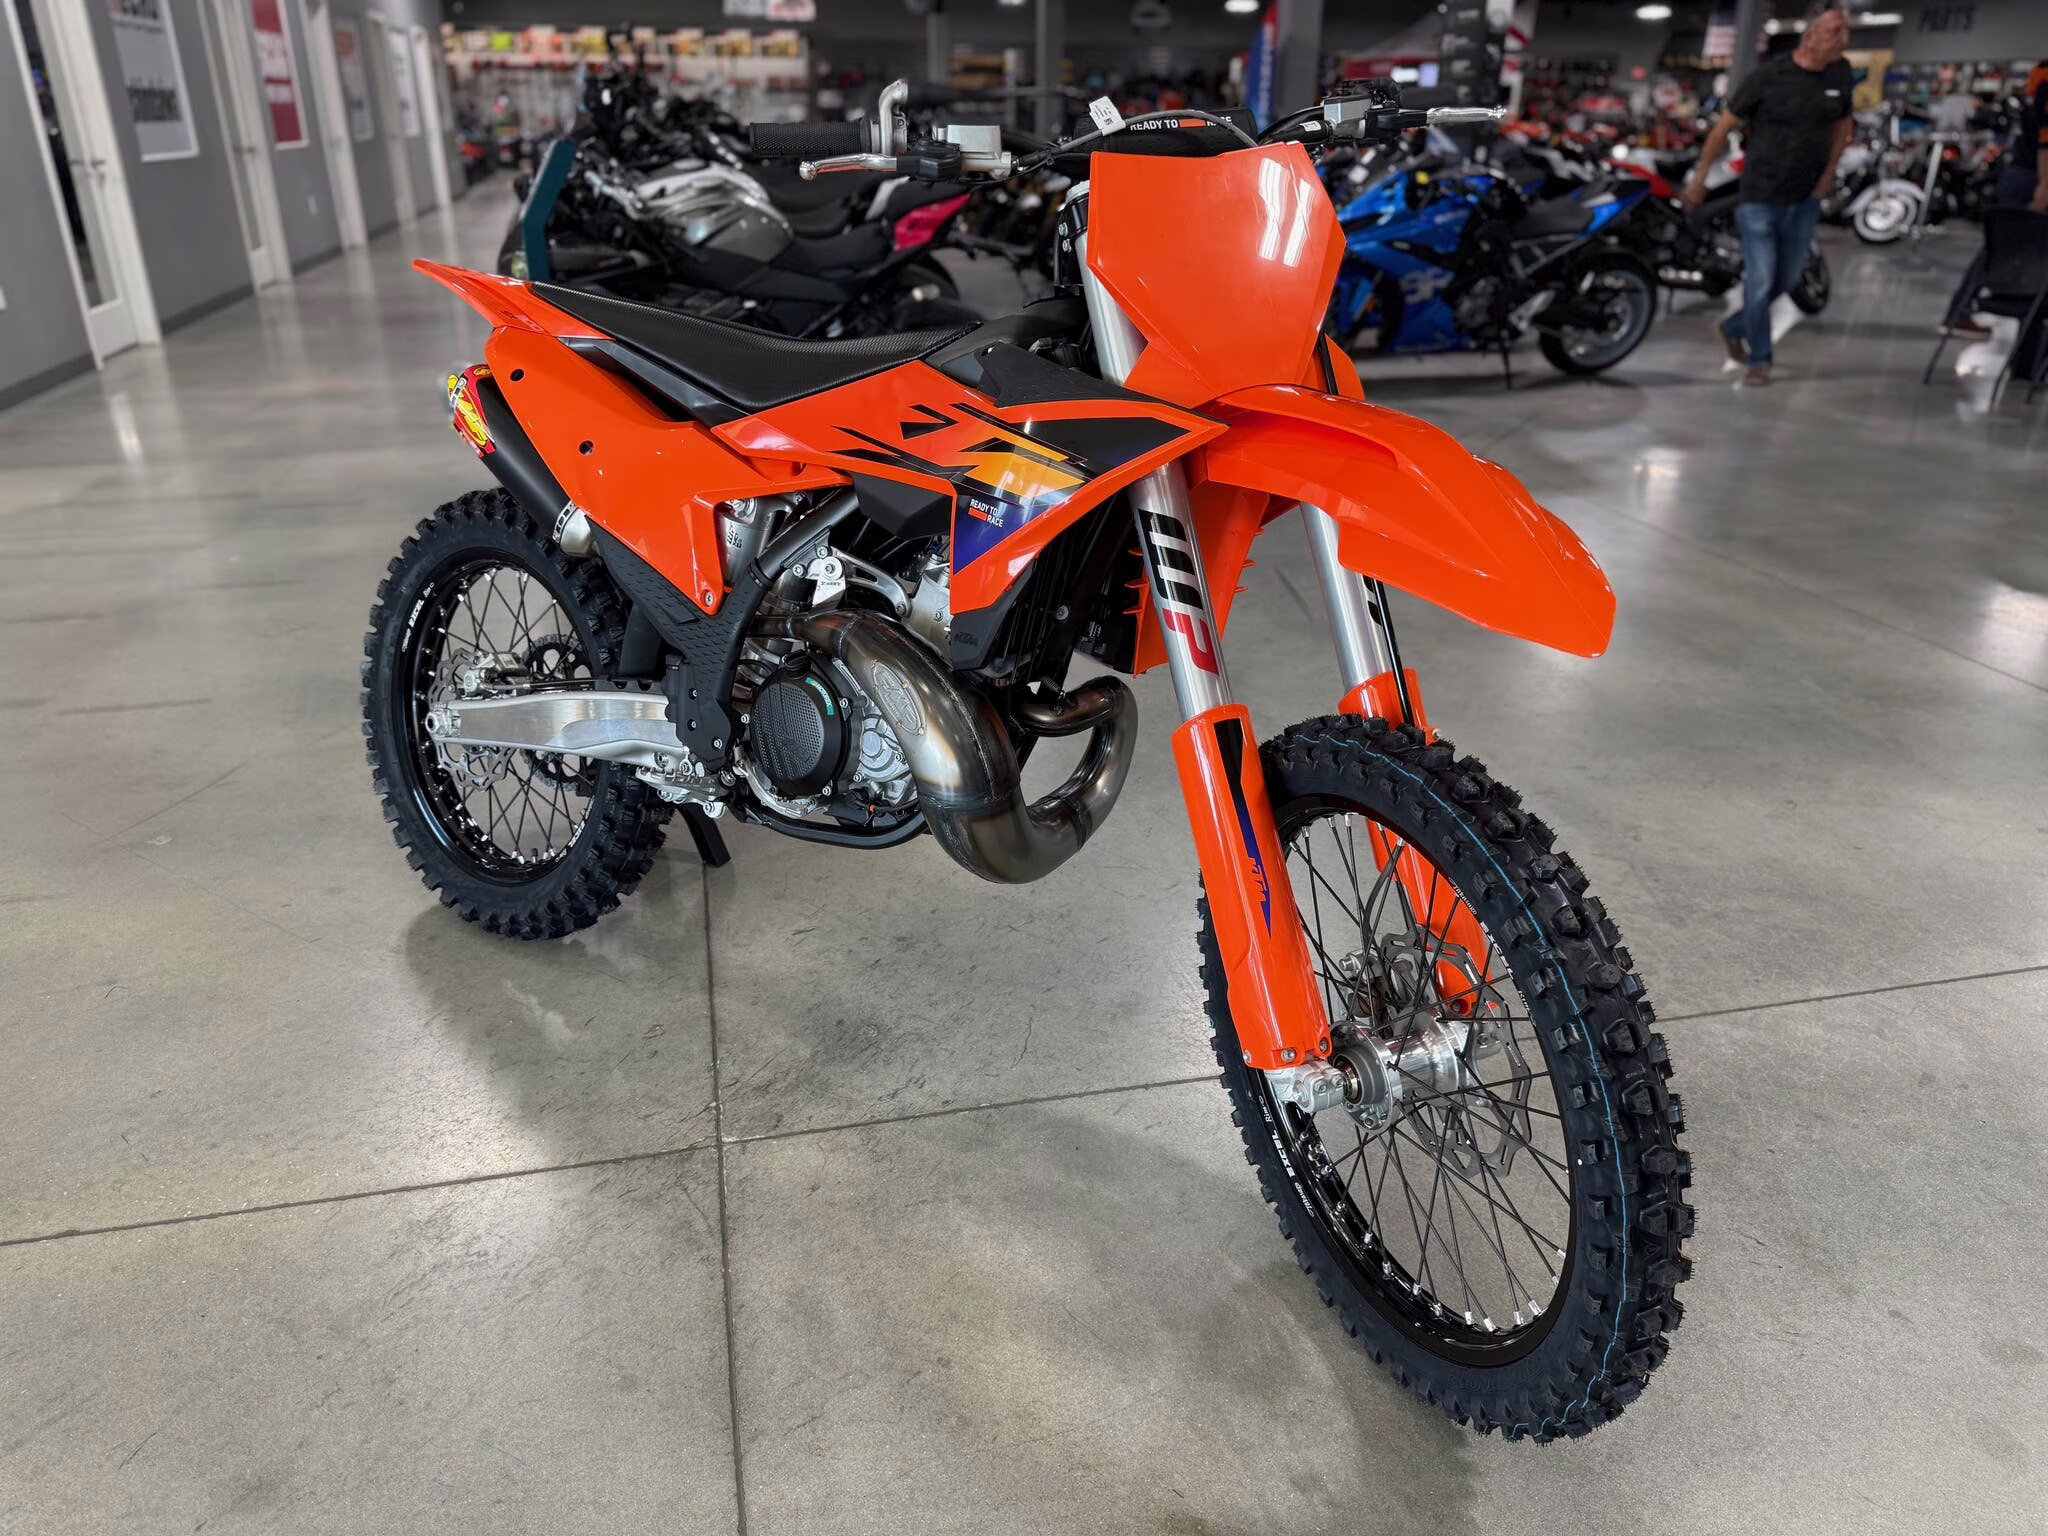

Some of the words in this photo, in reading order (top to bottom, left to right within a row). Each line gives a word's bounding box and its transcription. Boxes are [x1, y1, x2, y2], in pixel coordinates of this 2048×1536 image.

[1164, 119, 1179, 129] TO
[970, 498, 990, 513] READY
[989, 506, 998, 516] TO
[986, 514, 1004, 528] RACE
[1480, 920, 1515, 980] EXCEL
[1271, 1129, 1296, 1179] EXCEL
